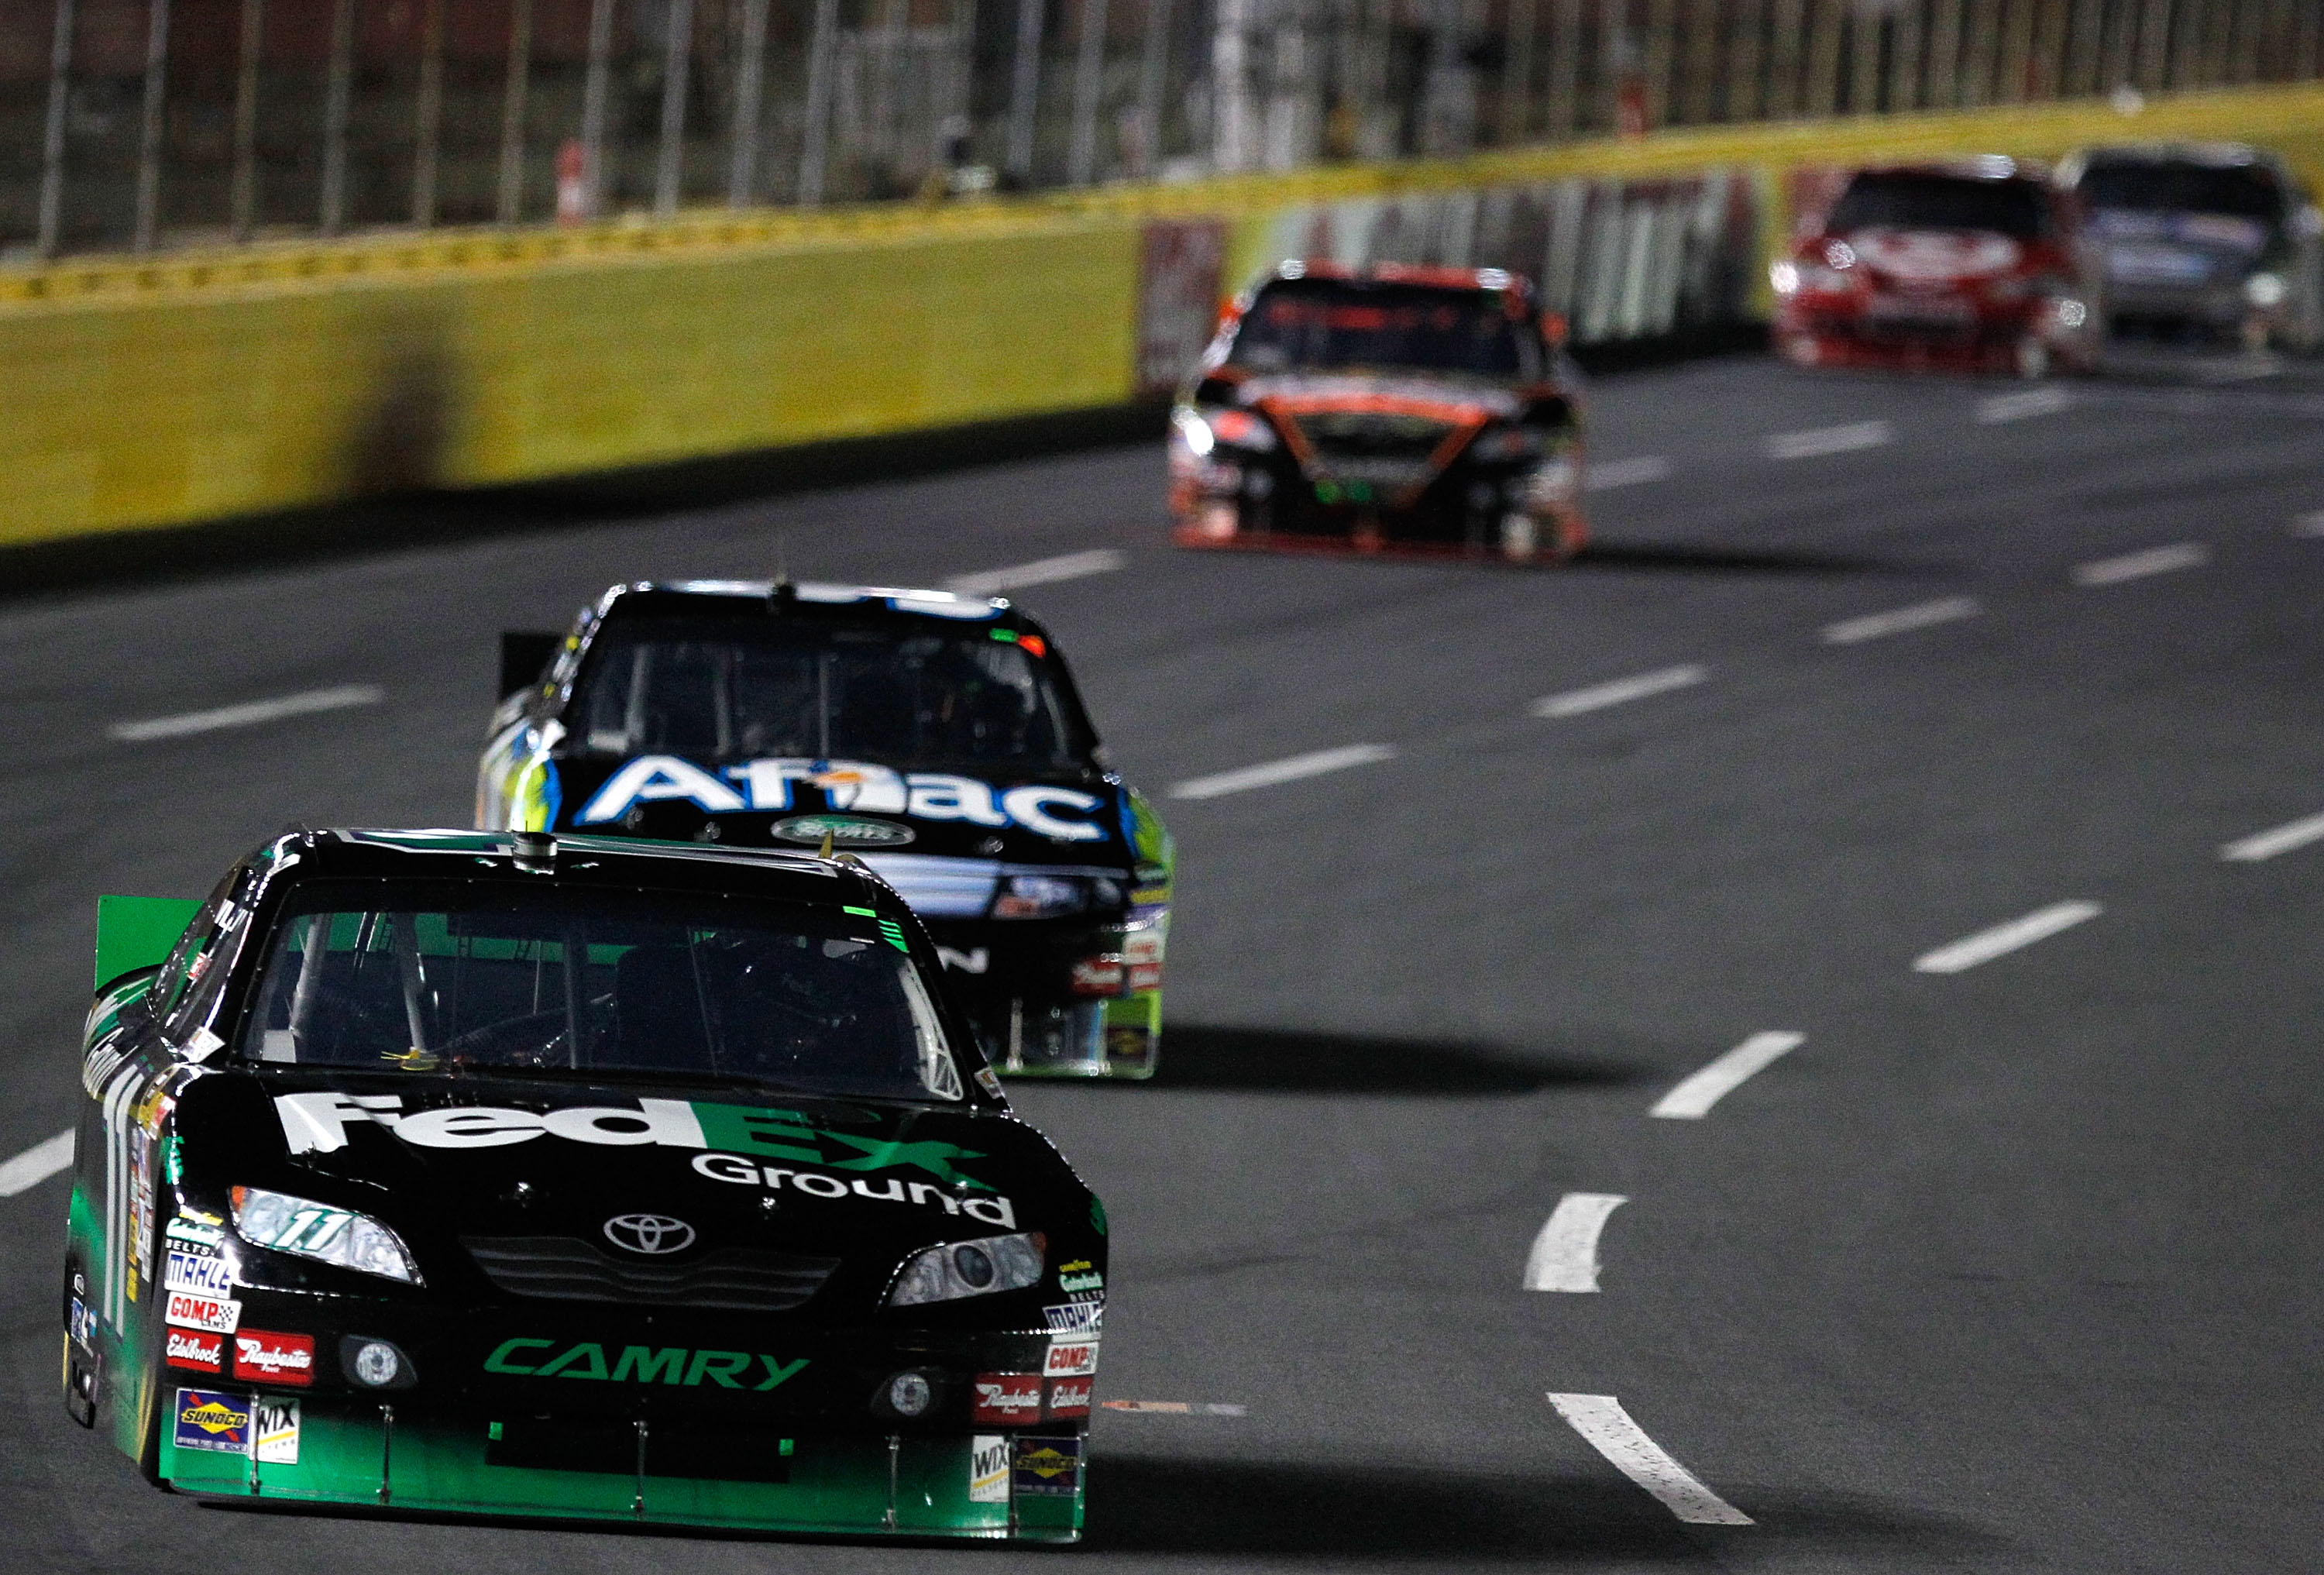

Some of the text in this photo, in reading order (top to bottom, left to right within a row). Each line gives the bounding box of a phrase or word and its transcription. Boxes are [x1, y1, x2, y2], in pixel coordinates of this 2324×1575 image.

[273, 1092, 1000, 1193] FedEx
[692, 1152, 1017, 1230] Ground
[270, 1207, 357, 1252] 11
[165, 1239, 211, 1257] BELTS
[171, 1296, 218, 1322] COMP
[167, 1333, 222, 1365] Edelbrock
[483, 1337, 811, 1391] CAMRY
[1049, 1346, 1088, 1369] COMP
[184, 1410, 246, 1426] SUNOCO
[973, 1444, 1009, 1478] WIX
